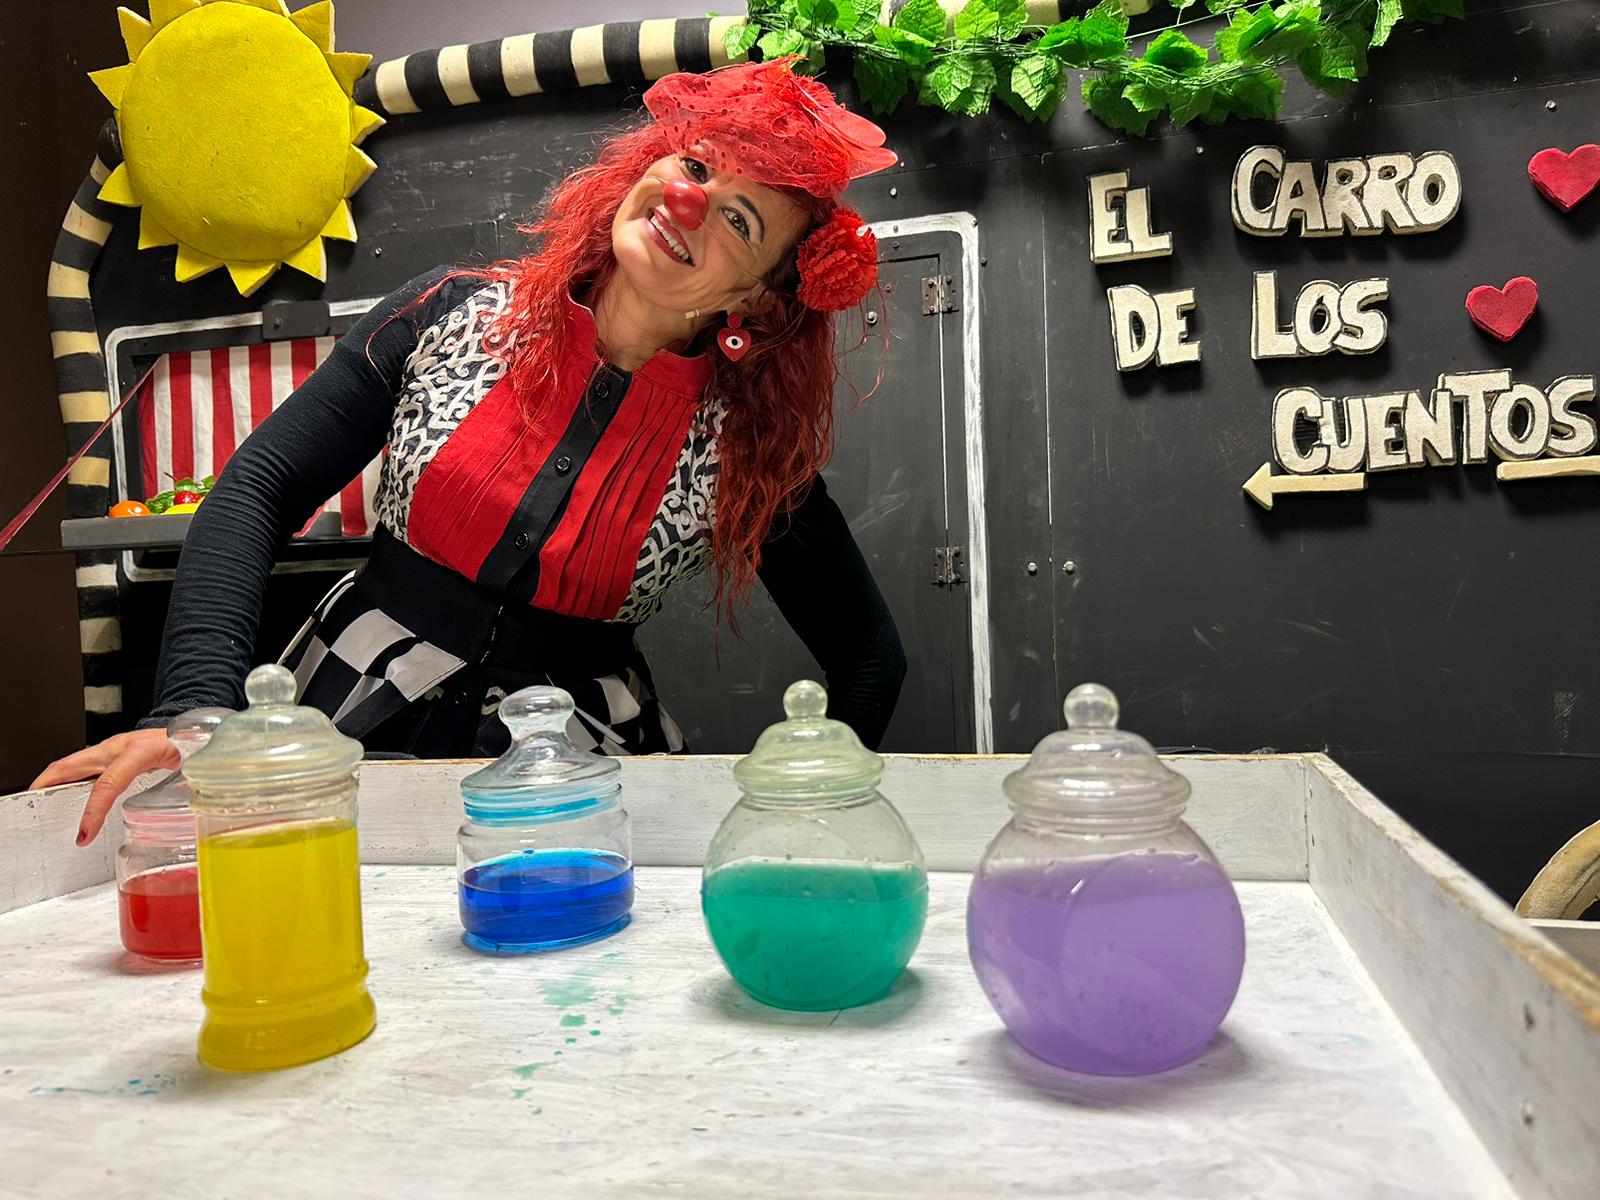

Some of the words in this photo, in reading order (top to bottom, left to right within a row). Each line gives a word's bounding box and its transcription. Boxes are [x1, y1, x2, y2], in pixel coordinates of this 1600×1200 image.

[1087, 169, 1173, 263] EL
[1230, 144, 1462, 237] CARRO
[1107, 284, 1201, 371] DE
[1251, 270, 1390, 360] LOS
[1273, 368, 1598, 474] CUENTOS
